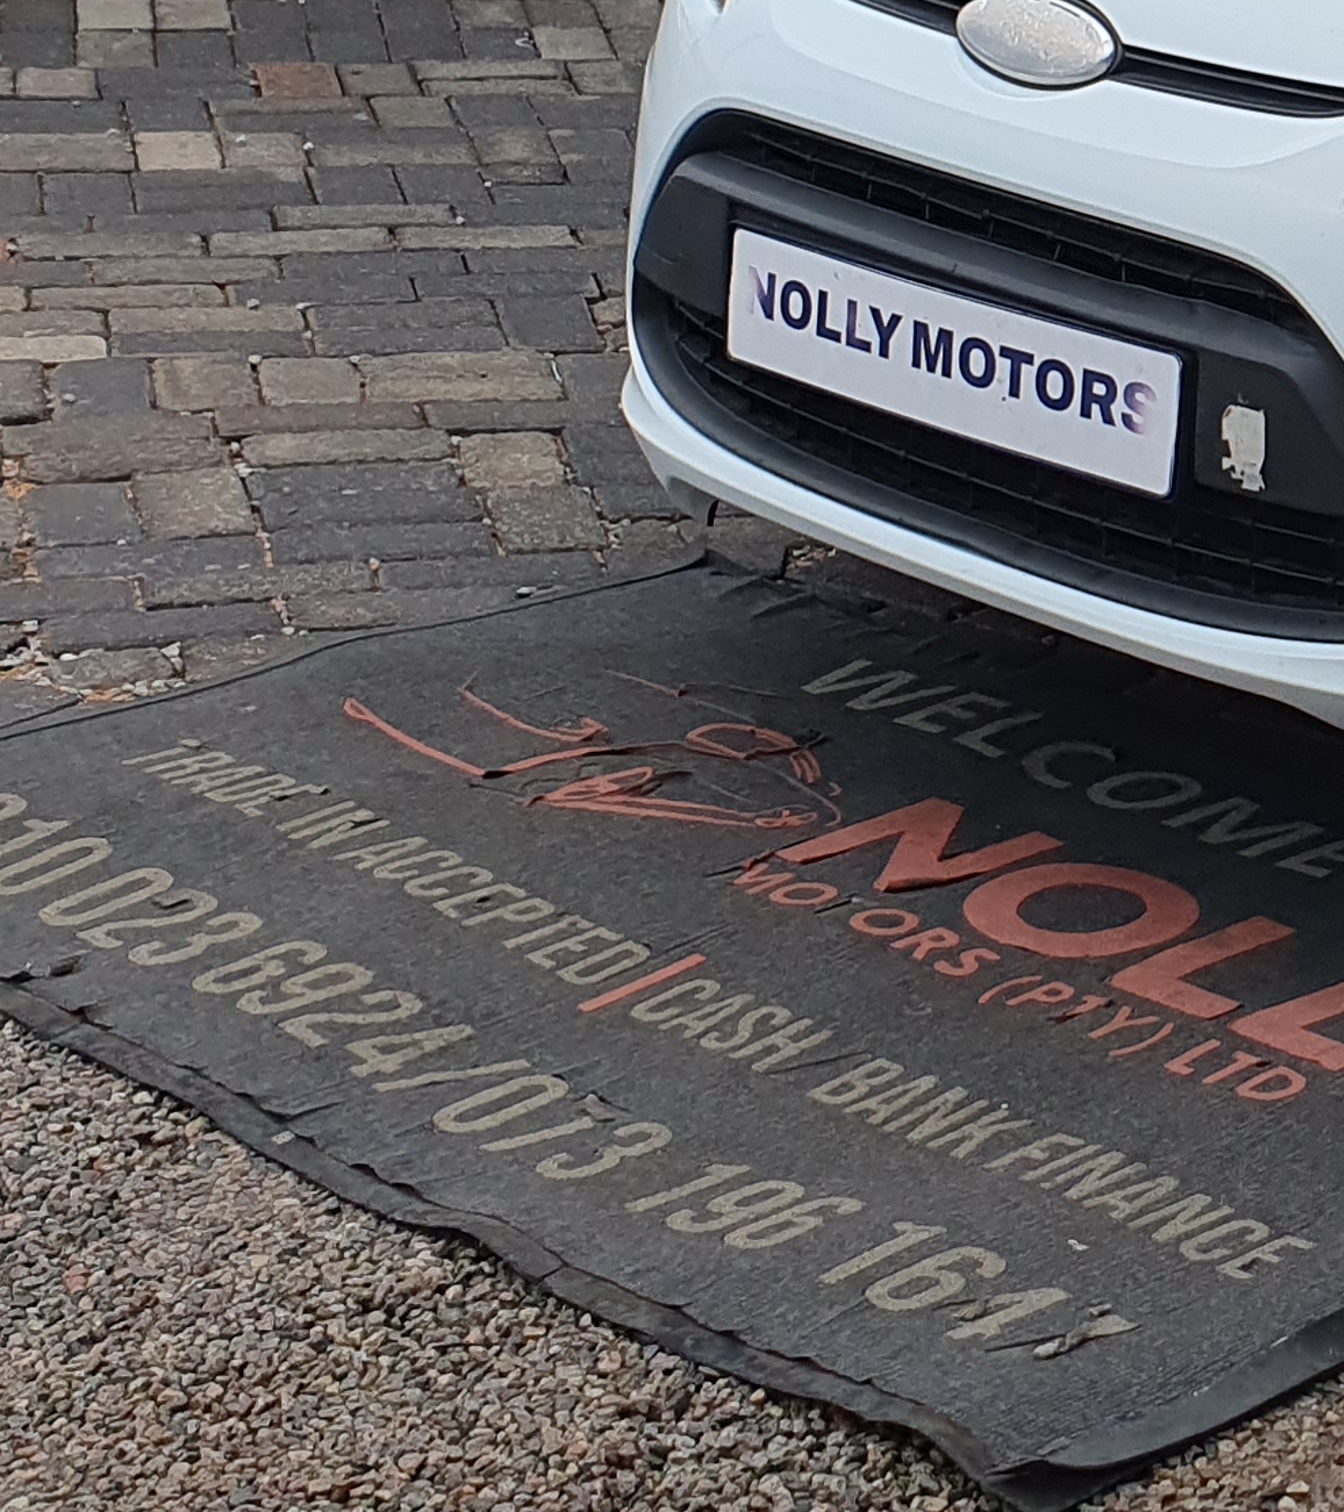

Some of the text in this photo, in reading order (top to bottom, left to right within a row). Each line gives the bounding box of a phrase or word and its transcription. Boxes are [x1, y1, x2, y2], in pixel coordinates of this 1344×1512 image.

[749, 265, 1158, 436] NOLLY MOTORS
[274, 800, 392, 850] IN
[328, 835, 652, 986] ACCEPTED
[630, 978, 835, 1074] CASH
[733, 862, 1001, 977] MOORS
[1163, 1038, 1308, 1102] LTD
[805, 1057, 1034, 1160] BANK
[623, 1164, 867, 1251] 196
[982, 1132, 1318, 1281] FINANCE
